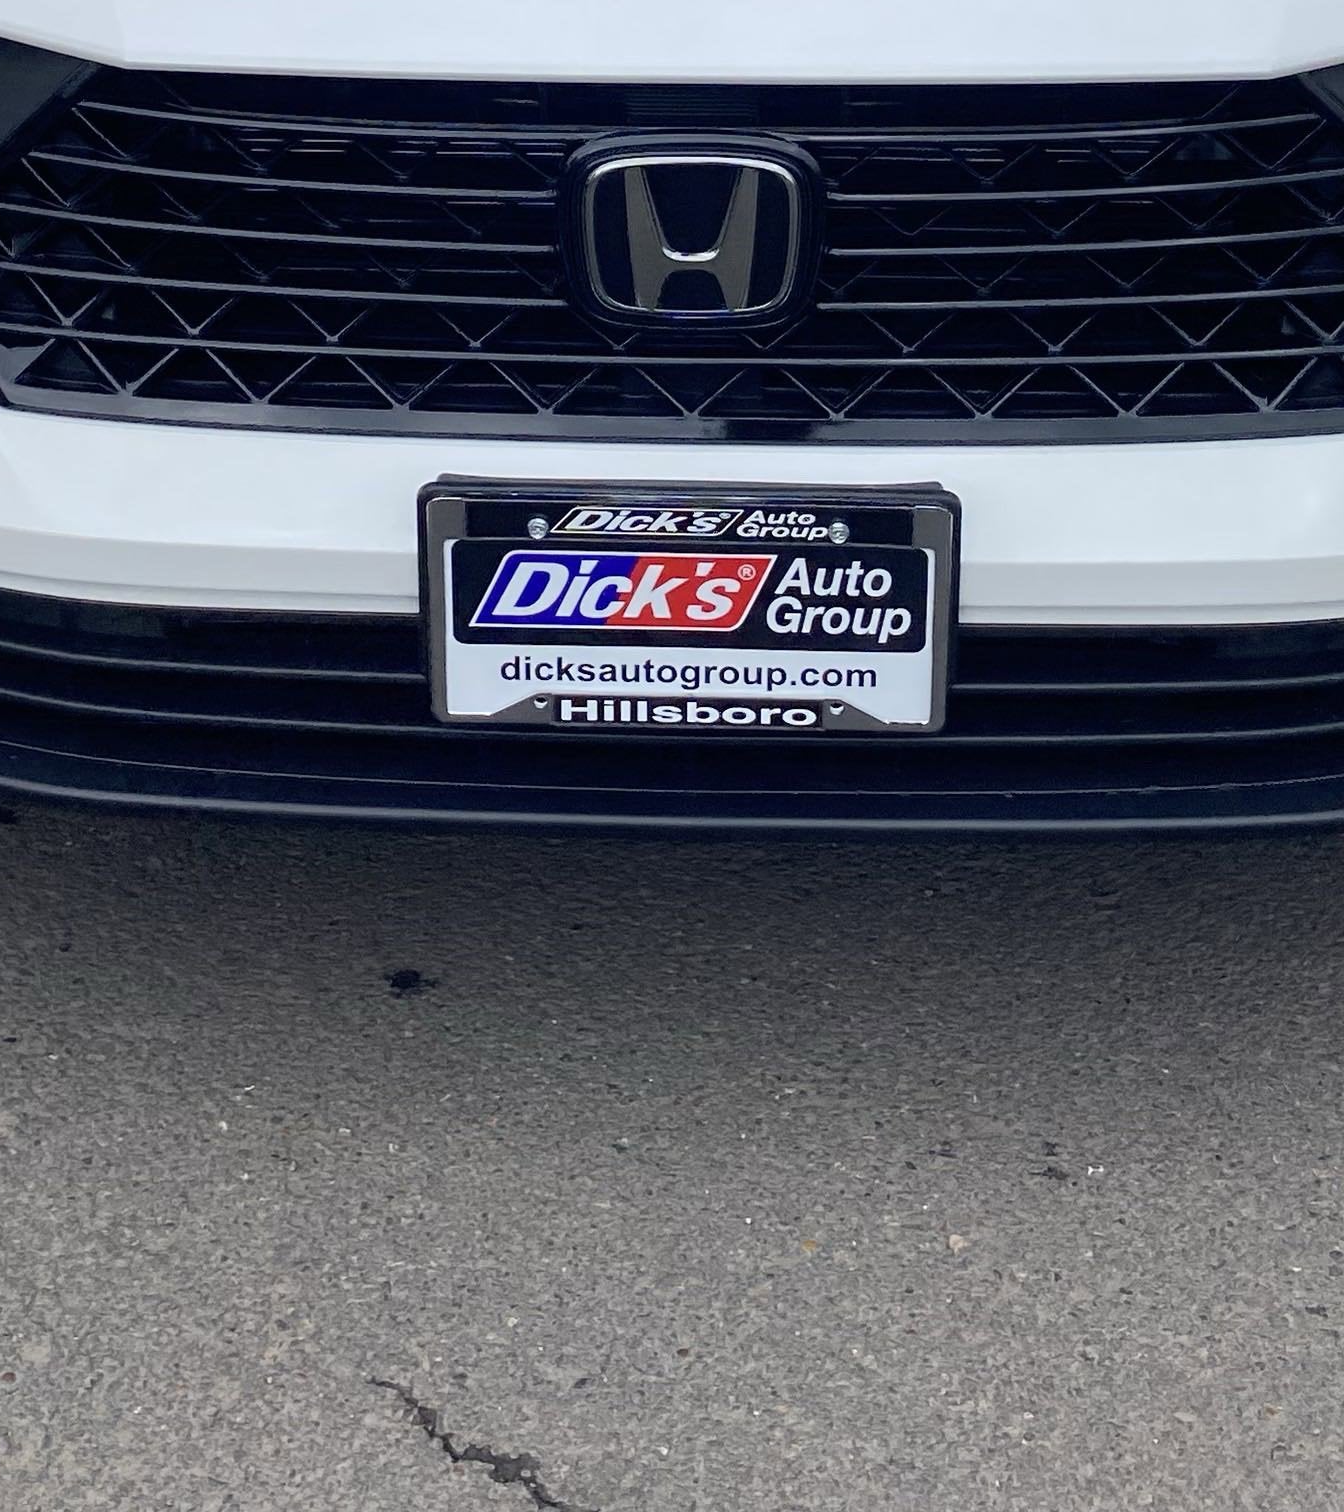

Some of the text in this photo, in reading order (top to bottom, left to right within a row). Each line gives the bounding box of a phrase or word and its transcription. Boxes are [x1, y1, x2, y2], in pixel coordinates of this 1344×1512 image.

[564, 509, 723, 534] Dick's
[736, 524, 829, 541] Group
[743, 509, 817, 525] Auto
[491, 559, 742, 621] Dick's
[774, 557, 893, 598] Auto
[765, 595, 912, 644] Group
[500, 655, 878, 691] dicksautogroup.com
[559, 698, 818, 727] Hillsboro
